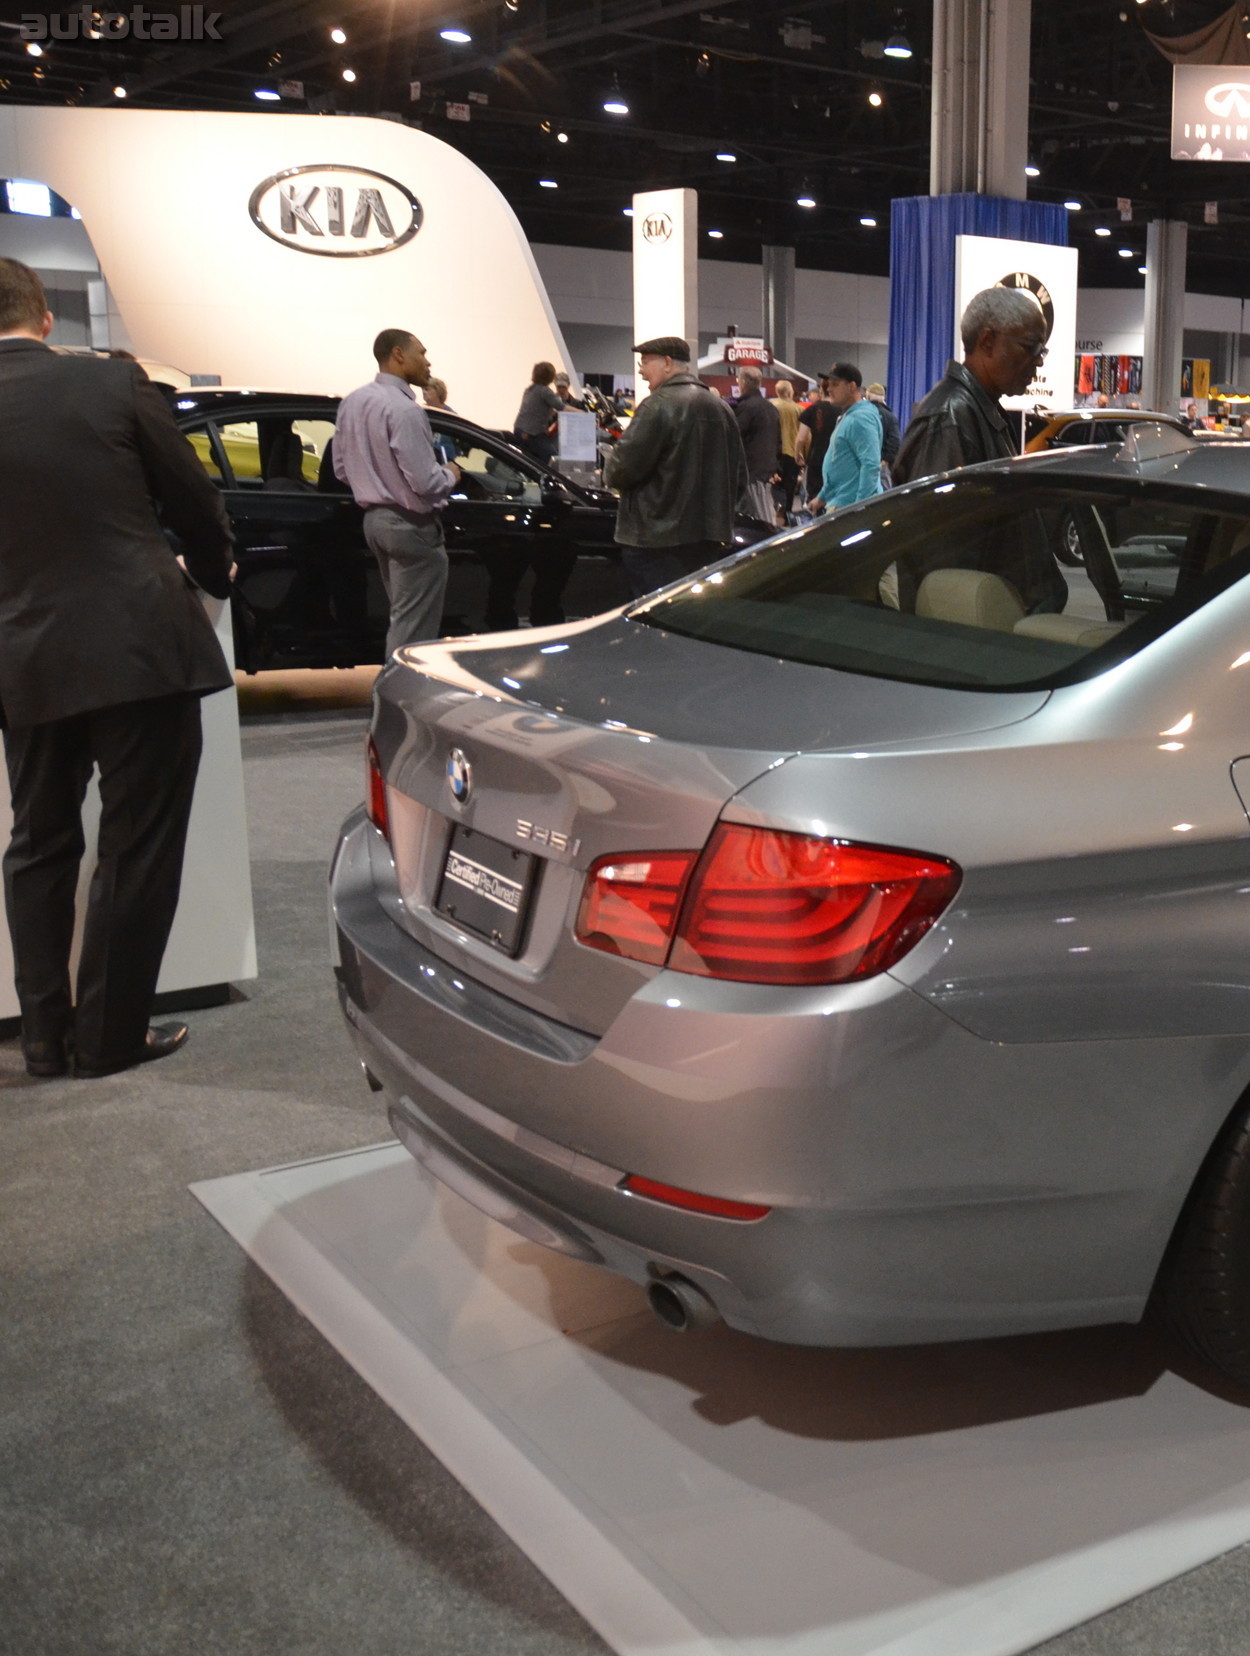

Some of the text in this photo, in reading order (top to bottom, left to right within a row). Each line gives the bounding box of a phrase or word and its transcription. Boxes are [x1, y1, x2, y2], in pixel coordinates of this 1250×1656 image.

[278, 185, 398, 239] KIA
[728, 348, 769, 363] GARAGE
[451, 858, 516, 904] Certified Pre-Owned
